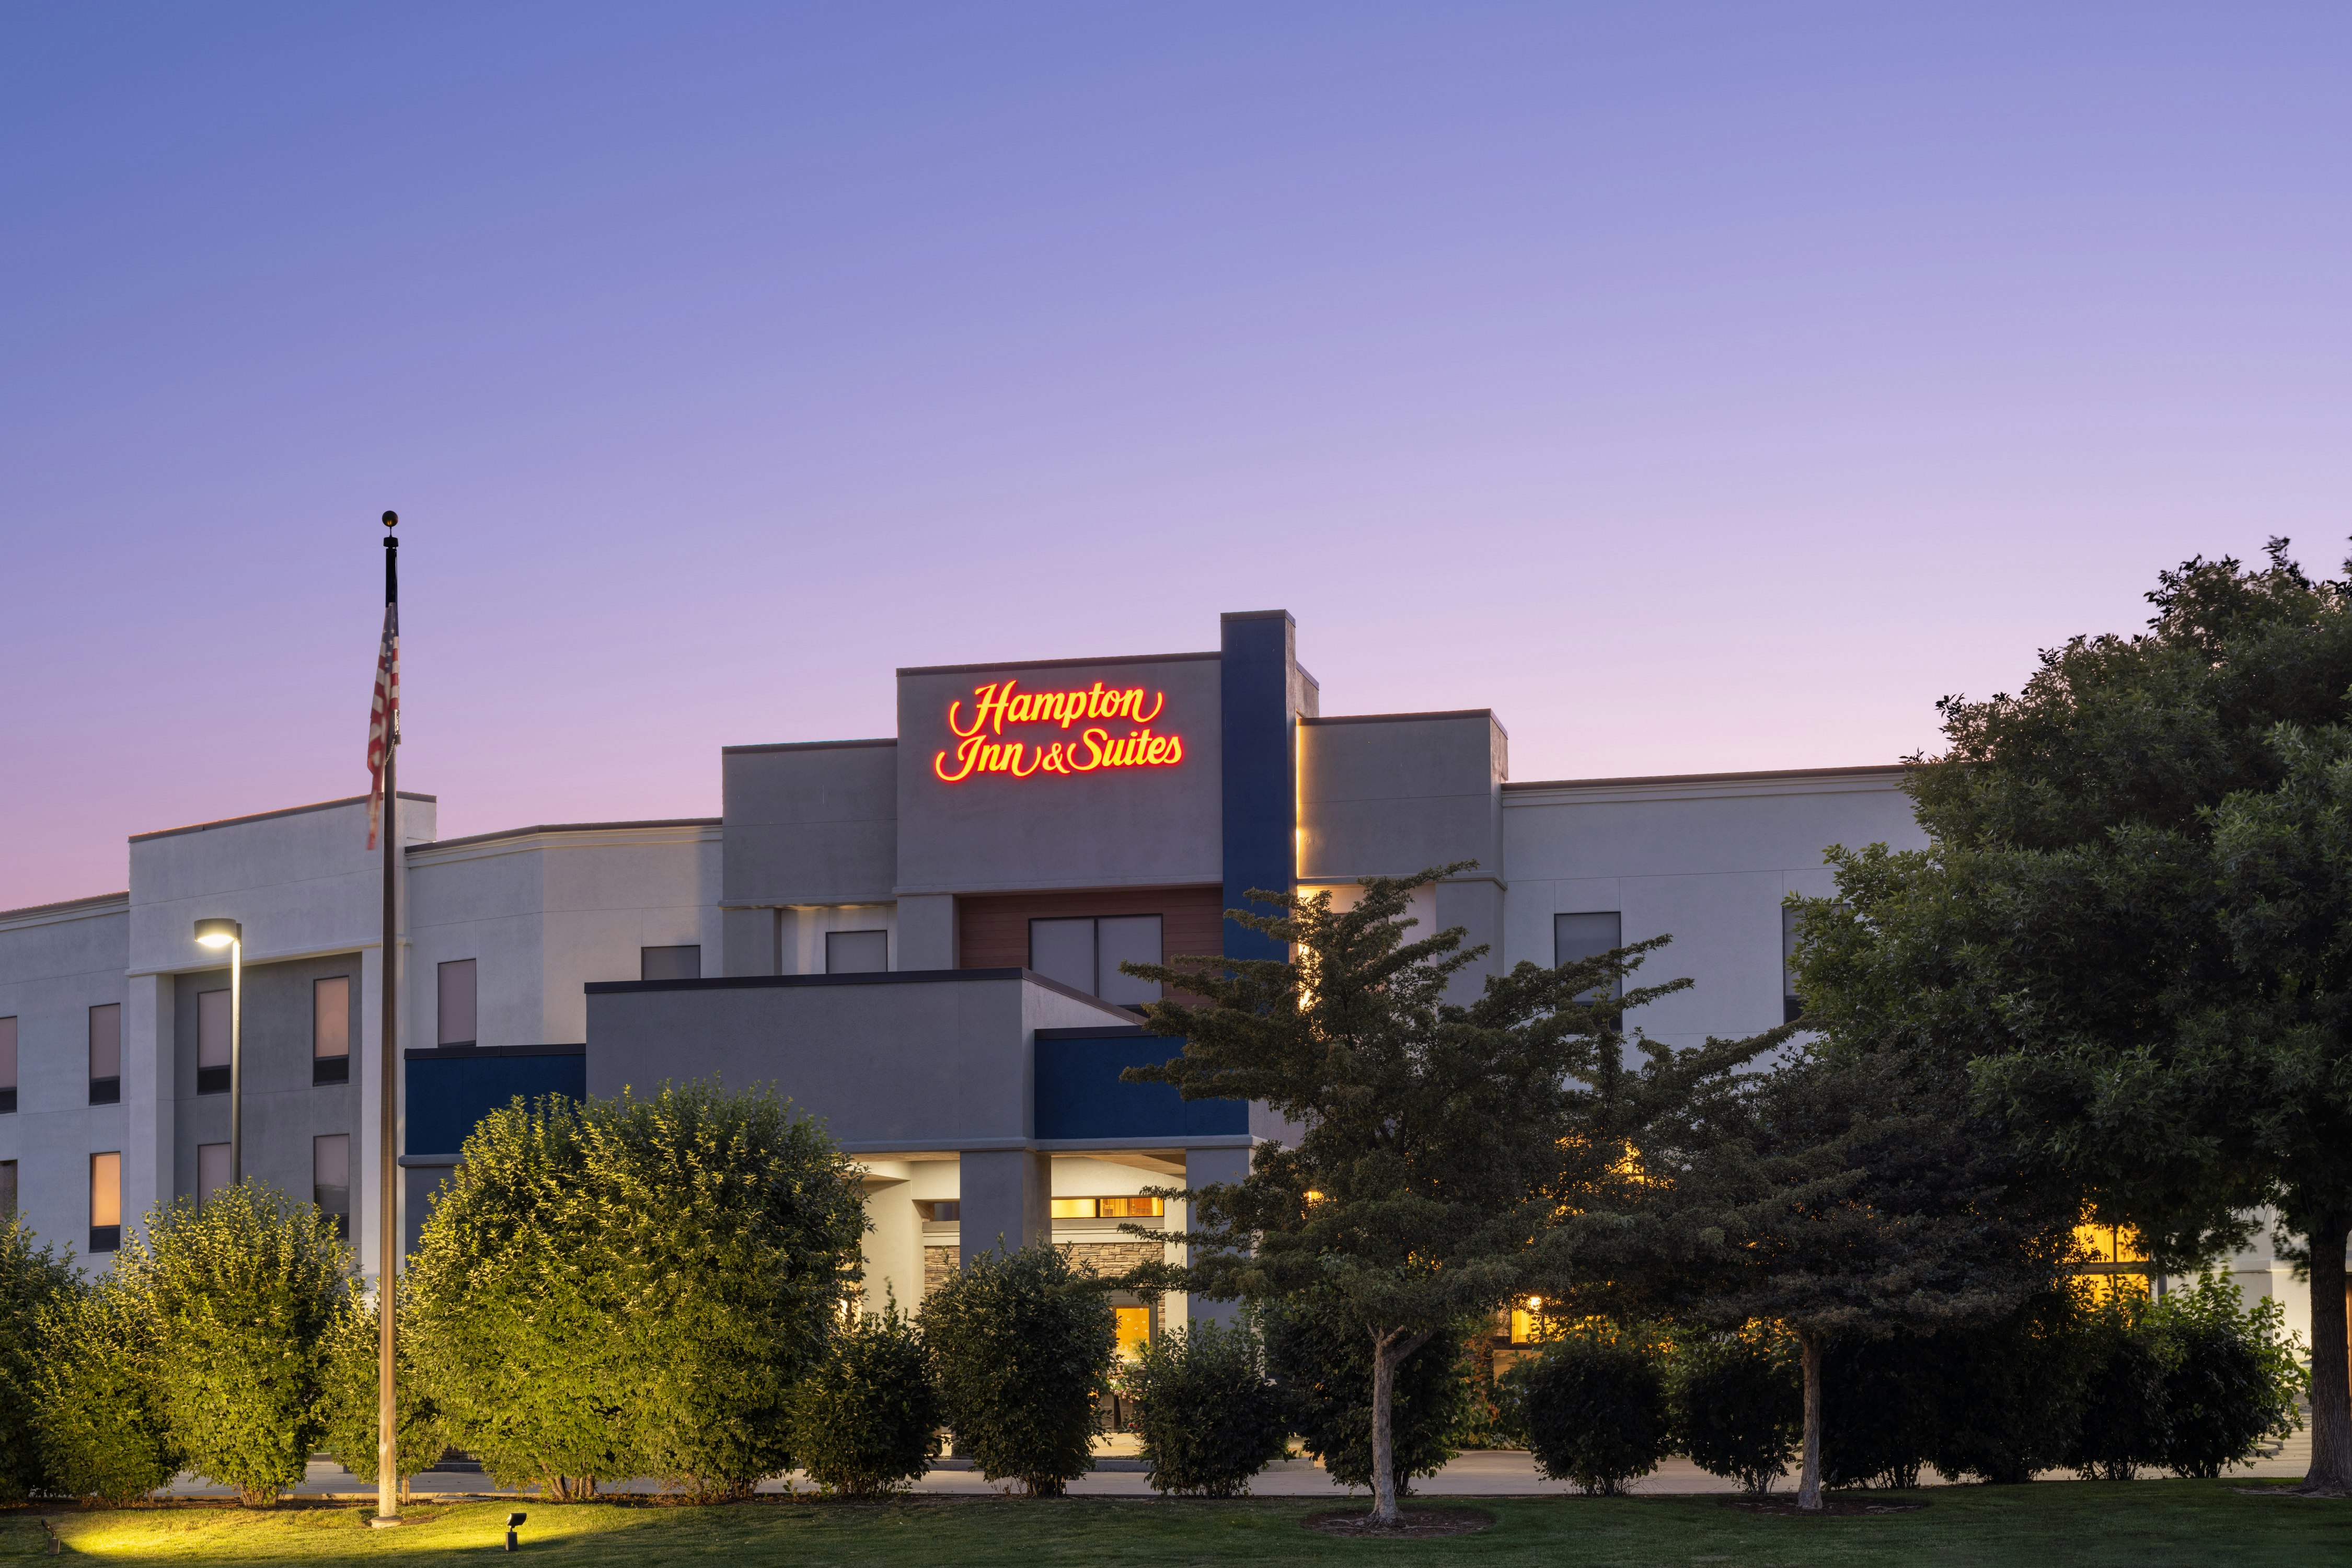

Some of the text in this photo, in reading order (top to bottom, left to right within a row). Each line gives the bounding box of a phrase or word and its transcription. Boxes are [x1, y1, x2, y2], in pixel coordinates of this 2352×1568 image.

[949, 679, 1163, 737] Hampton
[934, 727, 1184, 782] Inn & Suites
